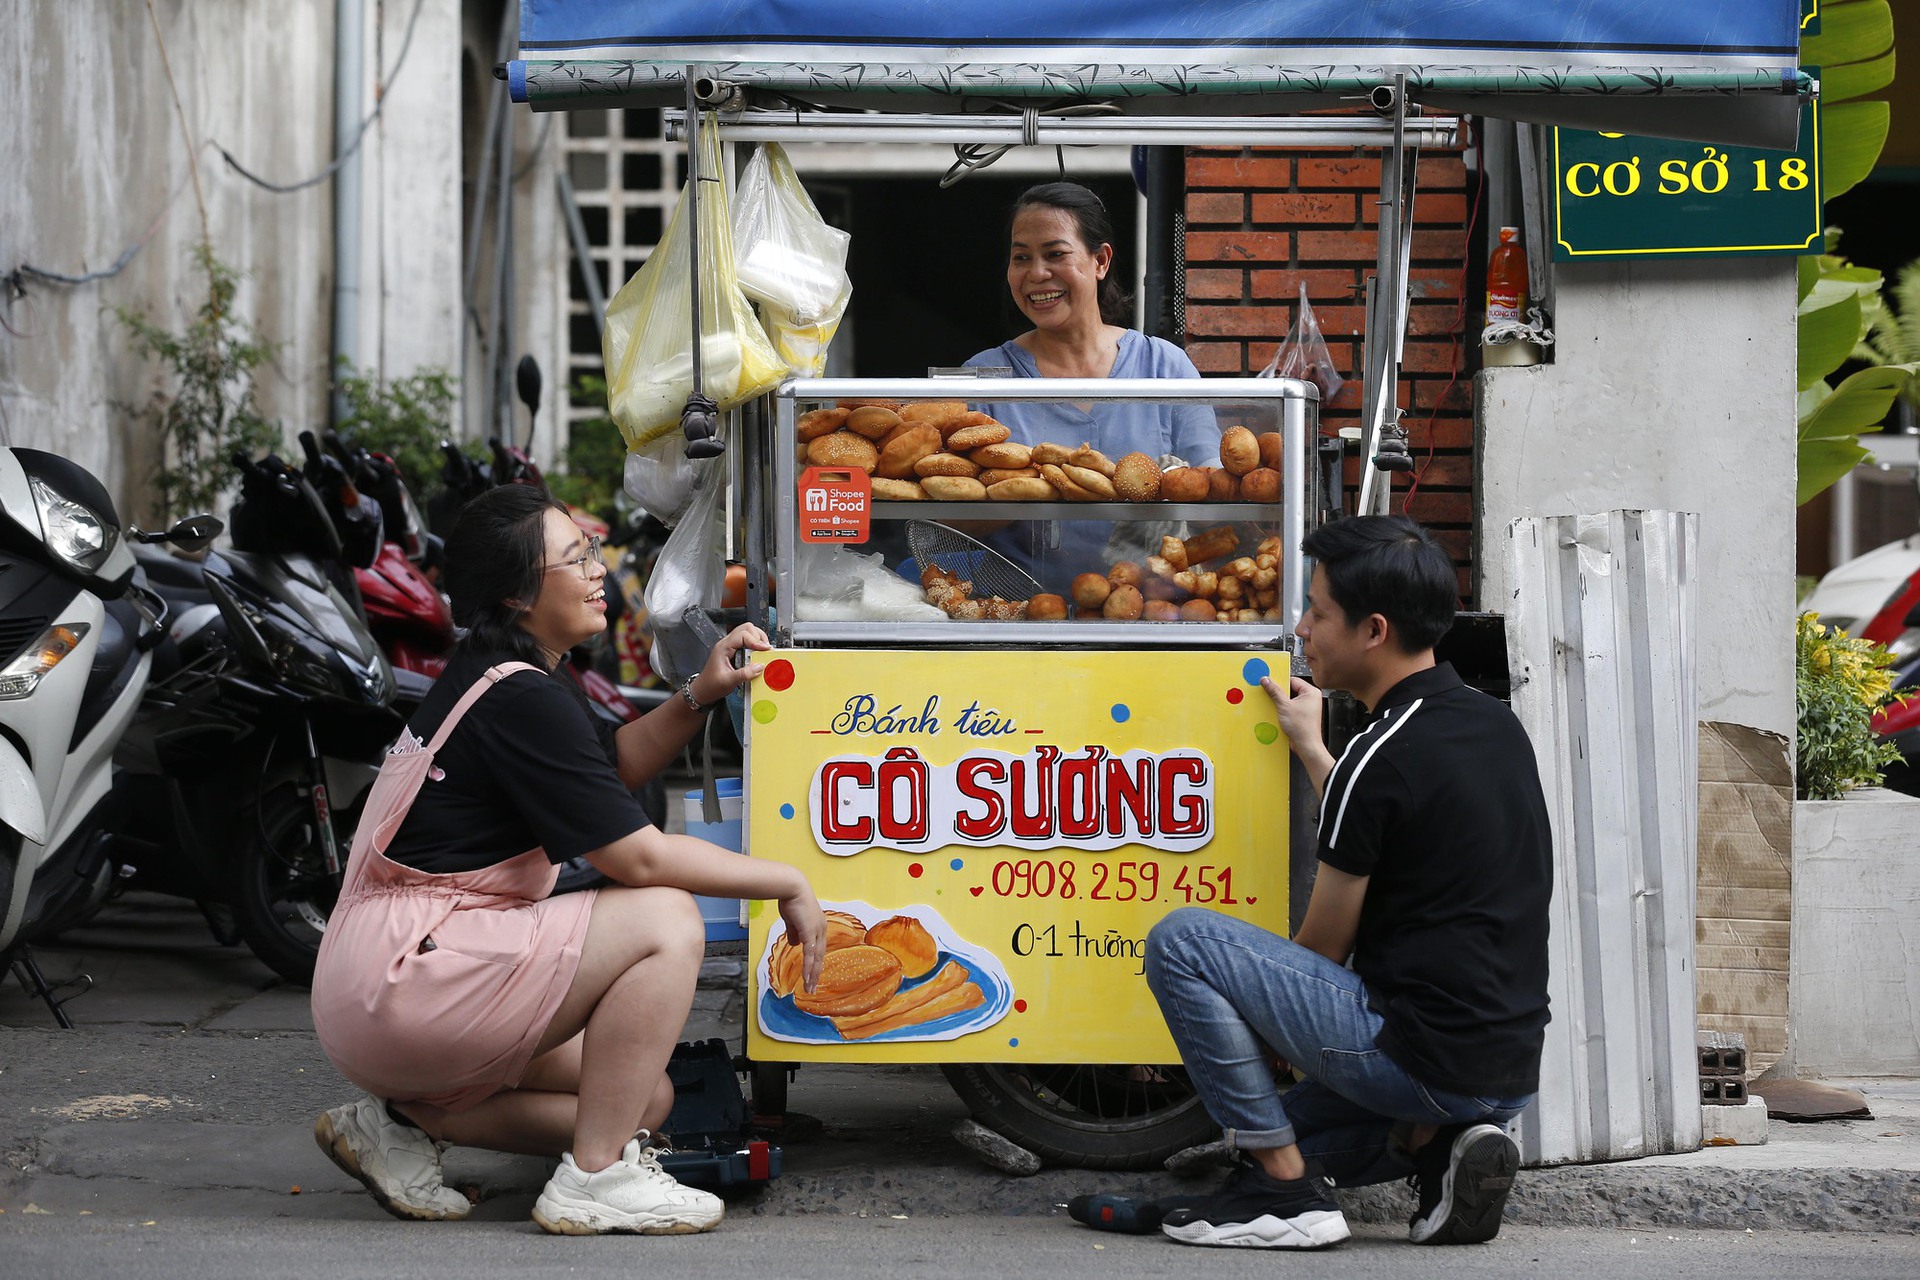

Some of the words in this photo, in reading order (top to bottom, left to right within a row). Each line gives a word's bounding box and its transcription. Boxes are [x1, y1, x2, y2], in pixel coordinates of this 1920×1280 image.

[1565, 156, 1642, 197] CƠ
[1657, 146, 1730, 195] SỞ
[1752, 157, 1810, 192] 18
[830, 488, 864, 500] Shopee
[830, 499, 864, 512] Food
[831, 693, 941, 736] Bánh
[953, 700, 1018, 737] tiêu
[821, 747, 930, 844] CÔ
[953, 744, 1210, 841] SƯƠNG
